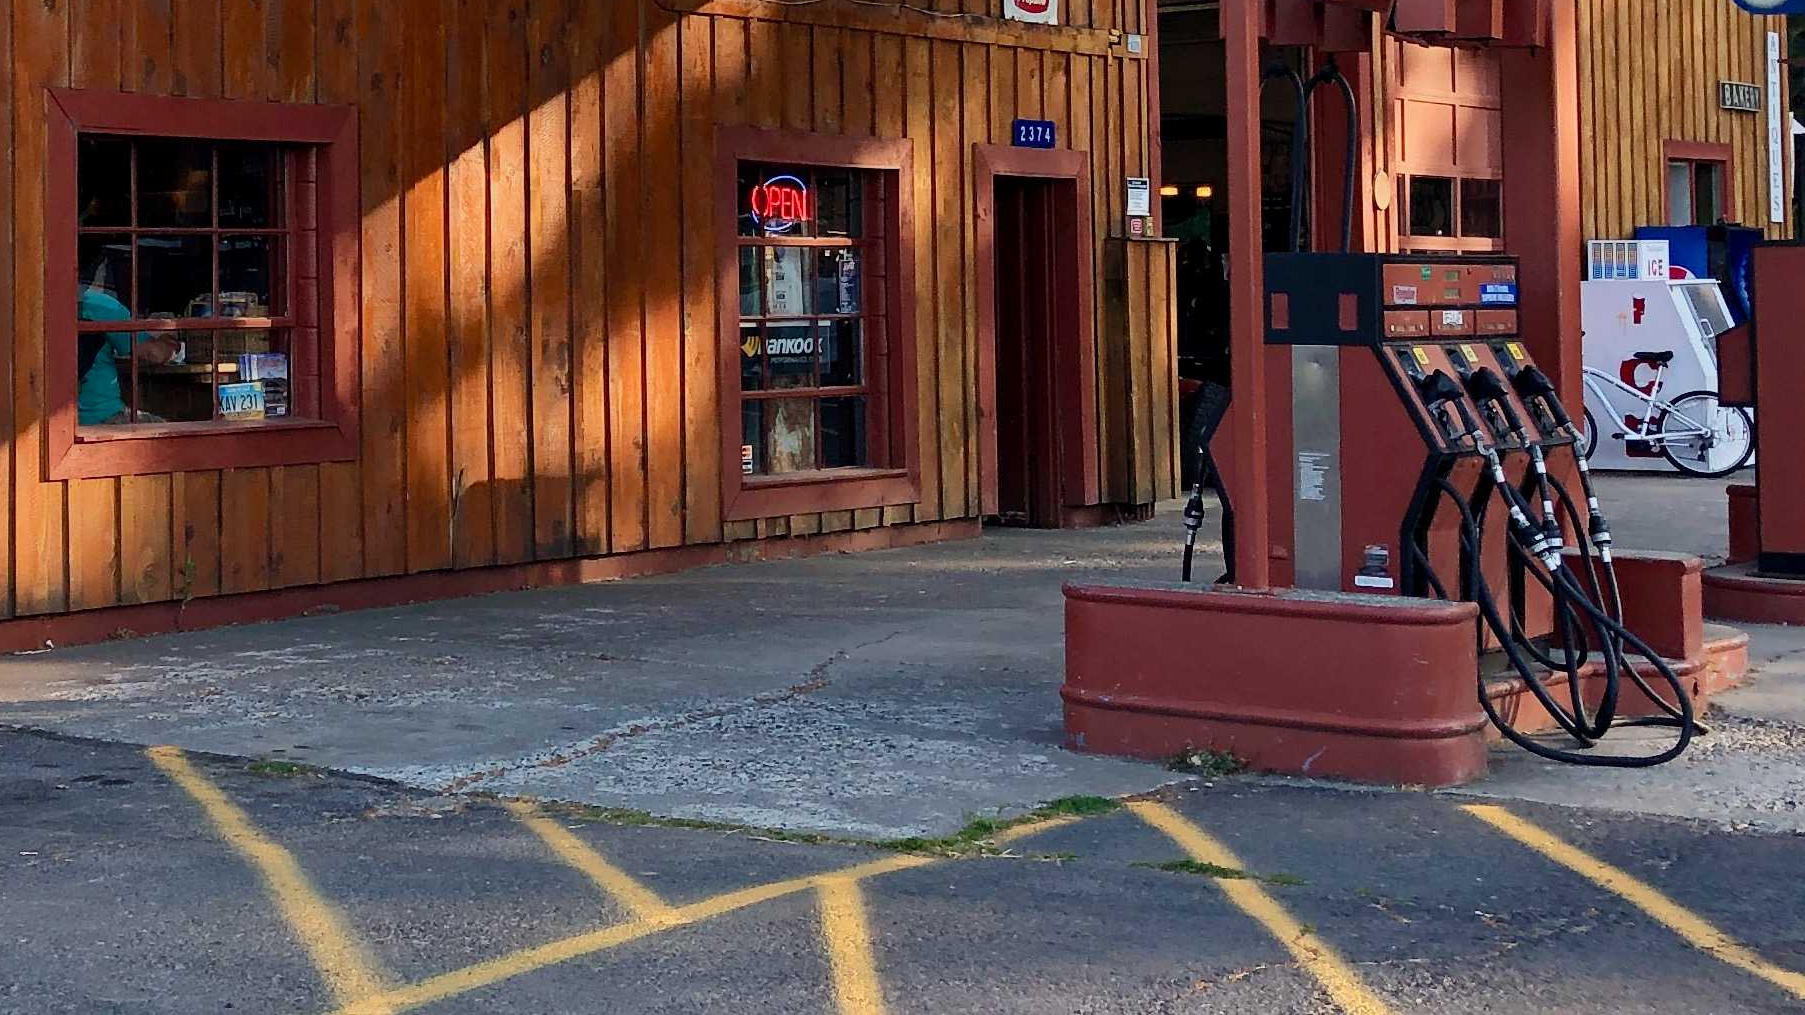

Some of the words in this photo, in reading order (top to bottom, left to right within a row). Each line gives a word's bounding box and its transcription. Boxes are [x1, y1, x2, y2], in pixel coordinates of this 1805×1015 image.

[1724, 83, 1760, 108] BAKERY
[1020, 125, 1051, 143] 2374
[1769, 35, 1780, 213] ANTIQUES
[751, 184, 807, 222] OPEN
[1648, 258, 1664, 277] ICE
[240, 393, 258, 411] 231
